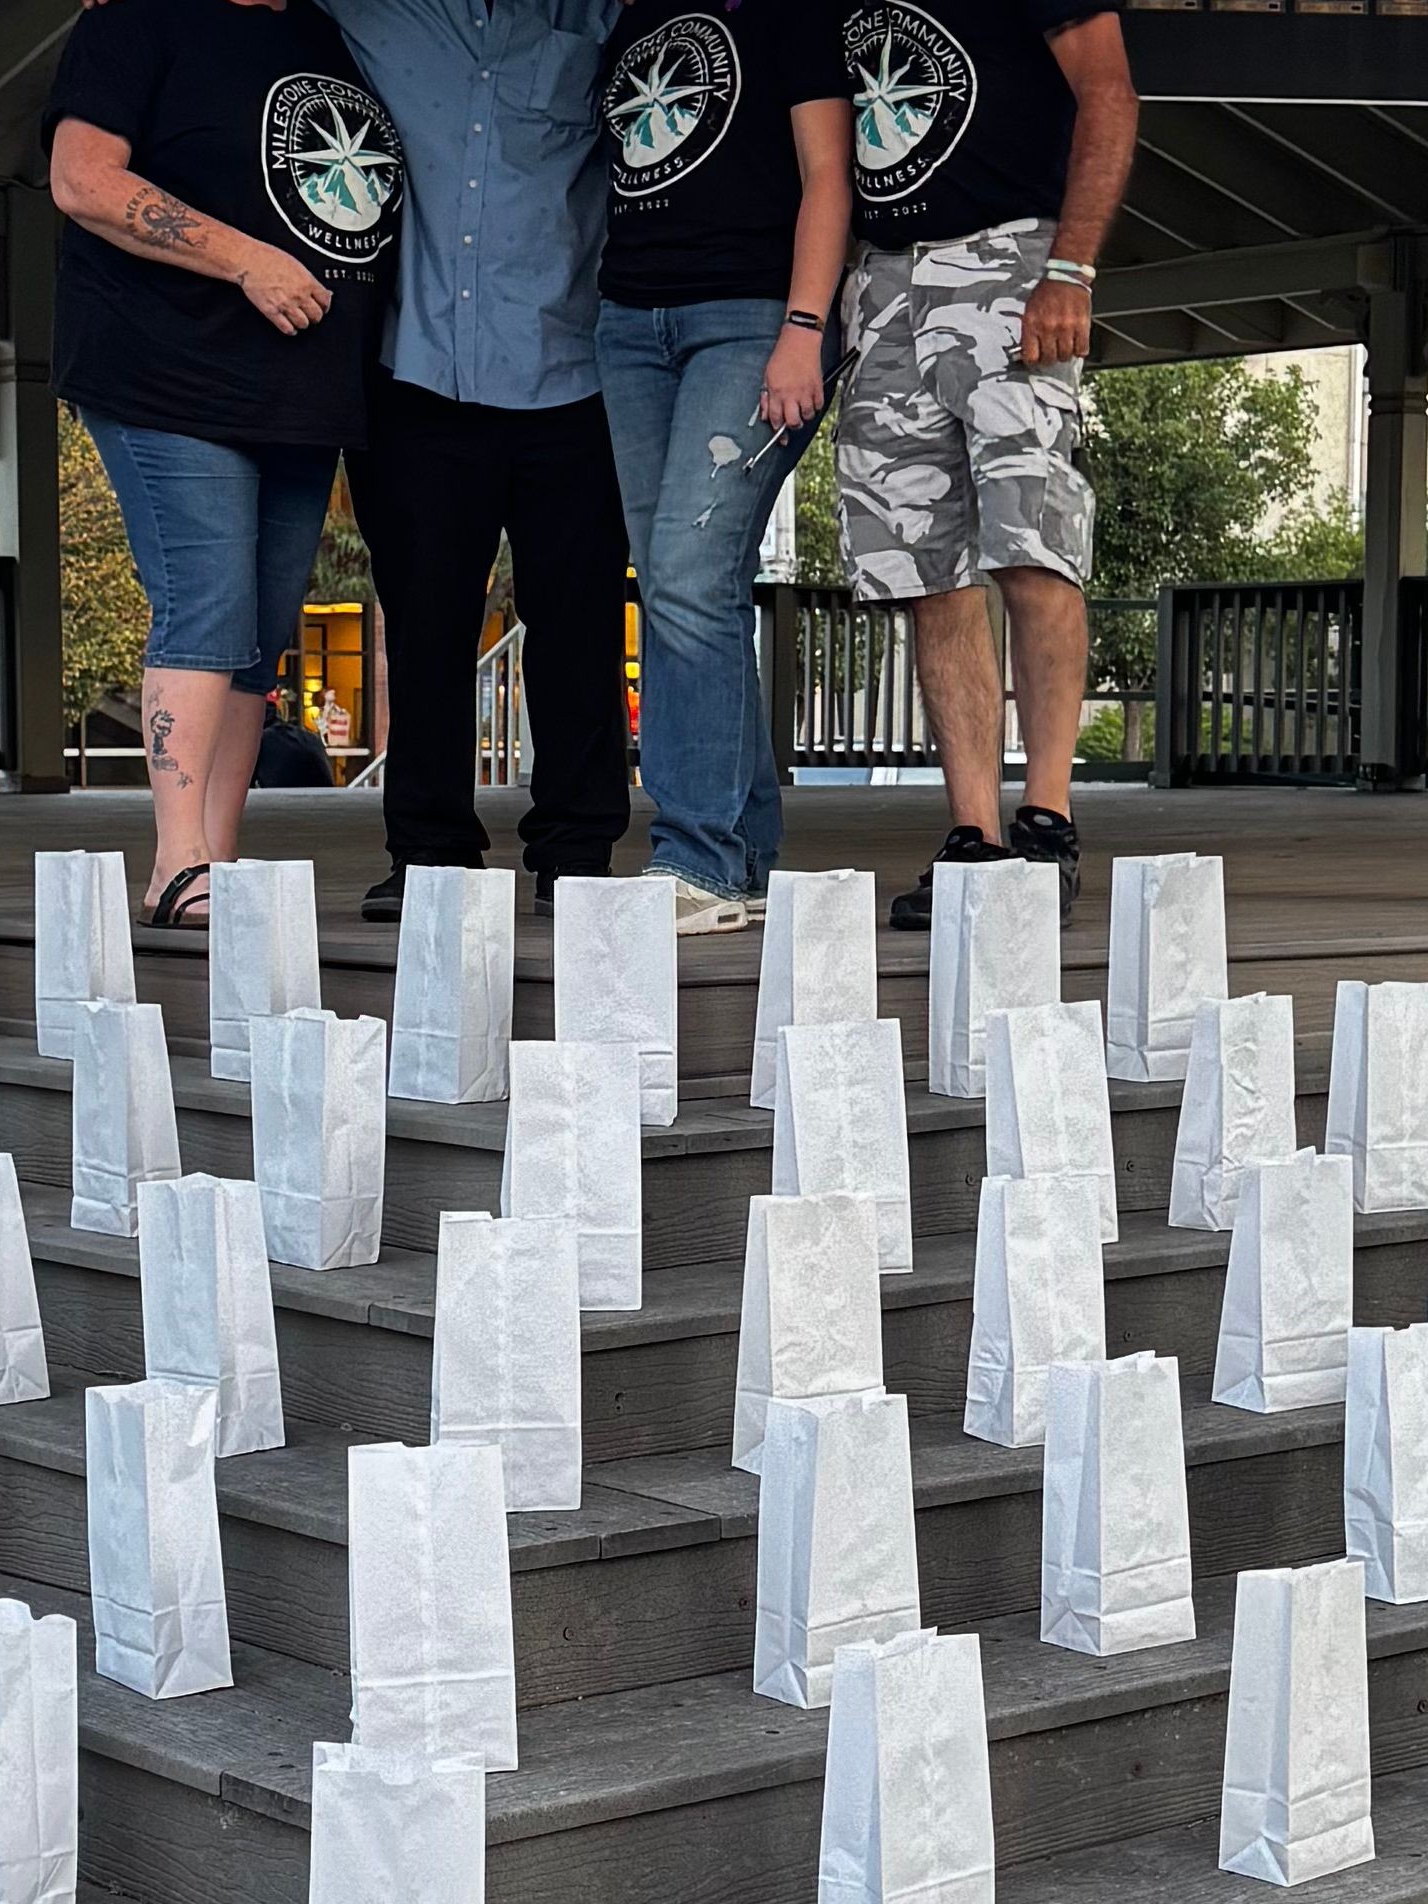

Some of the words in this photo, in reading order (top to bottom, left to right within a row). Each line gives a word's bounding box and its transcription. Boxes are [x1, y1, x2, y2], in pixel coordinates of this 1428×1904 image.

[670, 21, 732, 102] COMMUNITY
[890, 9, 967, 102] OMMUNITY
[271, 80, 318, 170] MILESTONE
